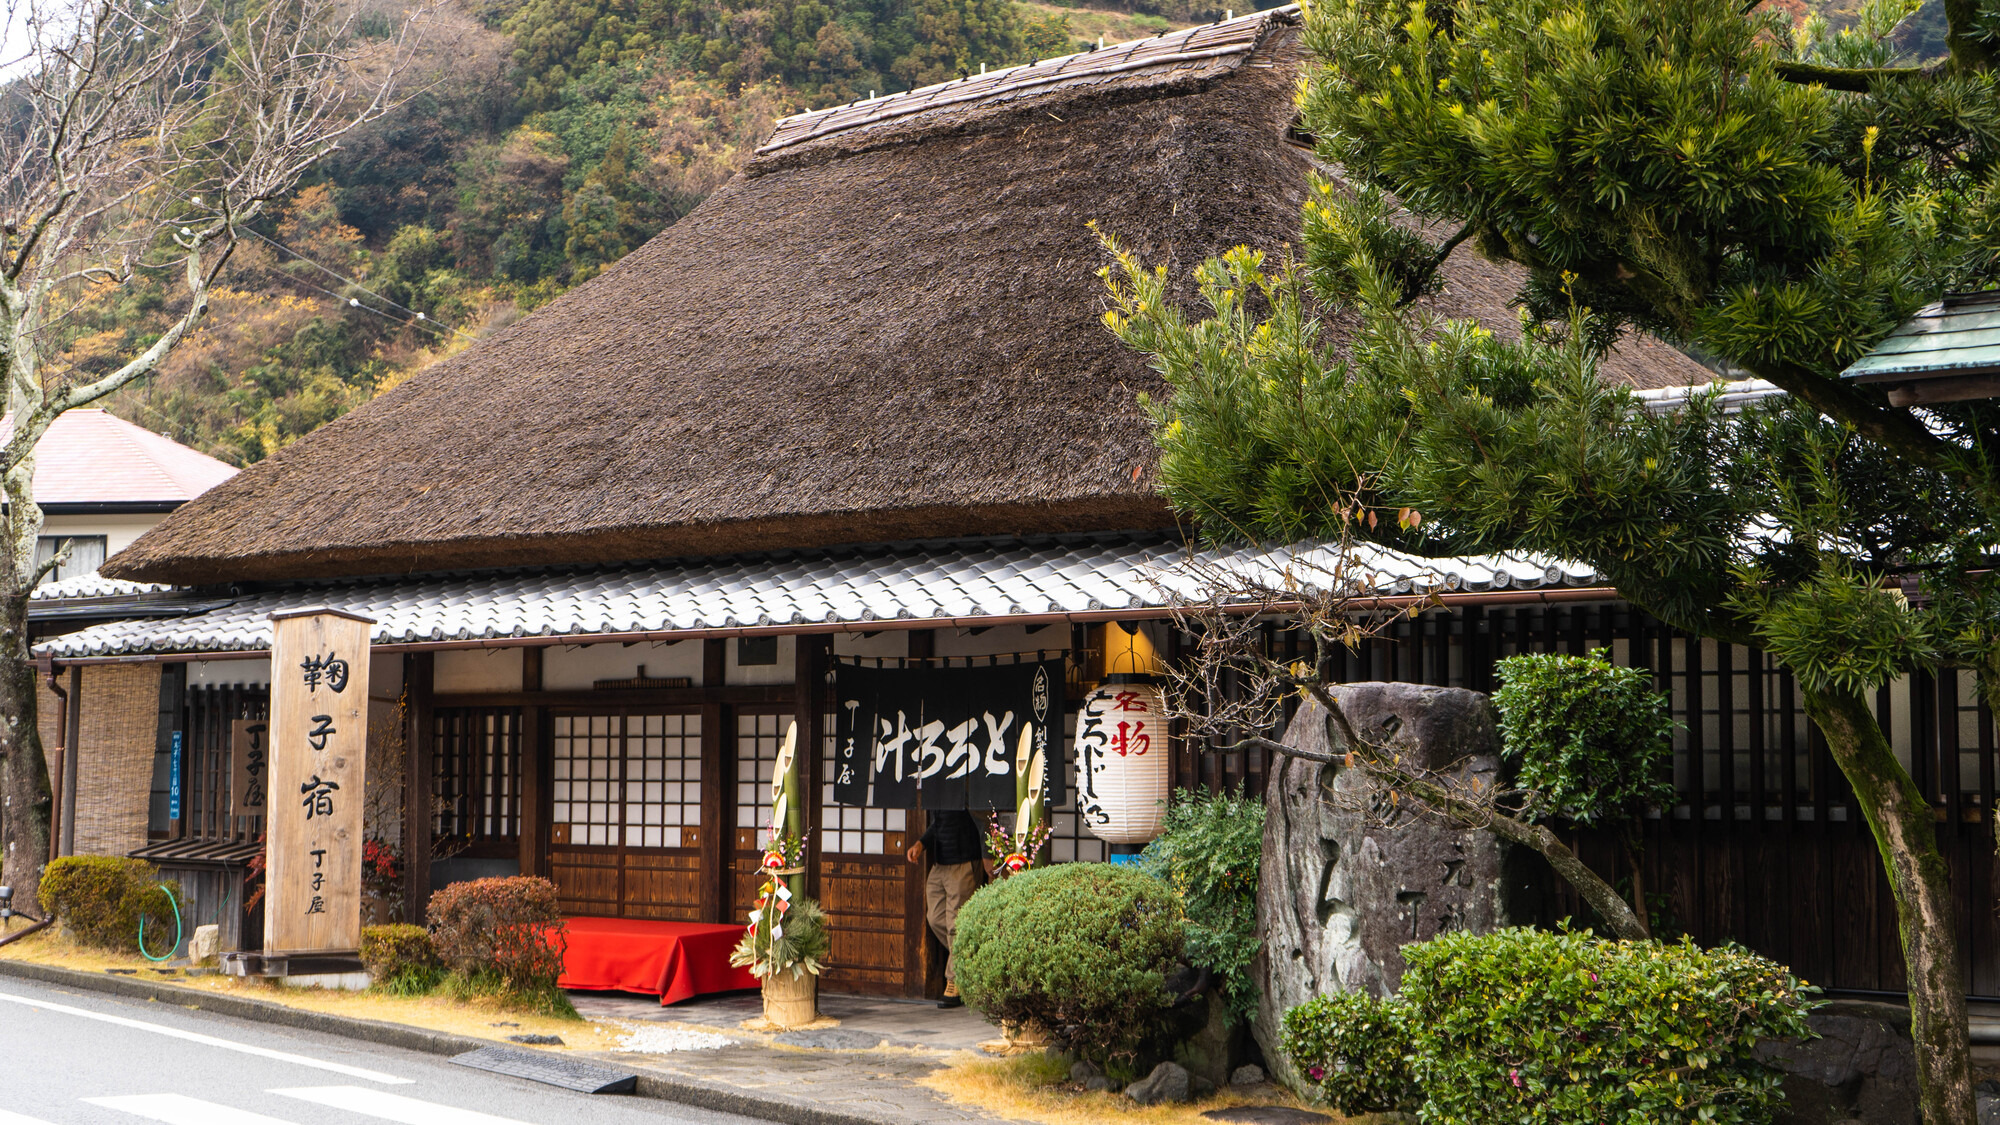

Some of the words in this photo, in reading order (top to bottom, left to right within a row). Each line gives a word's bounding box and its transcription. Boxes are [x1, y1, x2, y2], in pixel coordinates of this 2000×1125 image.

[1035, 675, 1047, 711] 名物
[1110, 690, 1150, 757] 名物
[243, 724, 267, 807] 丁子屋
[300, 651, 349, 820] 鞠子宿
[837, 700, 860, 785] 丁子屋
[304, 850, 326, 915] 丁子屋
